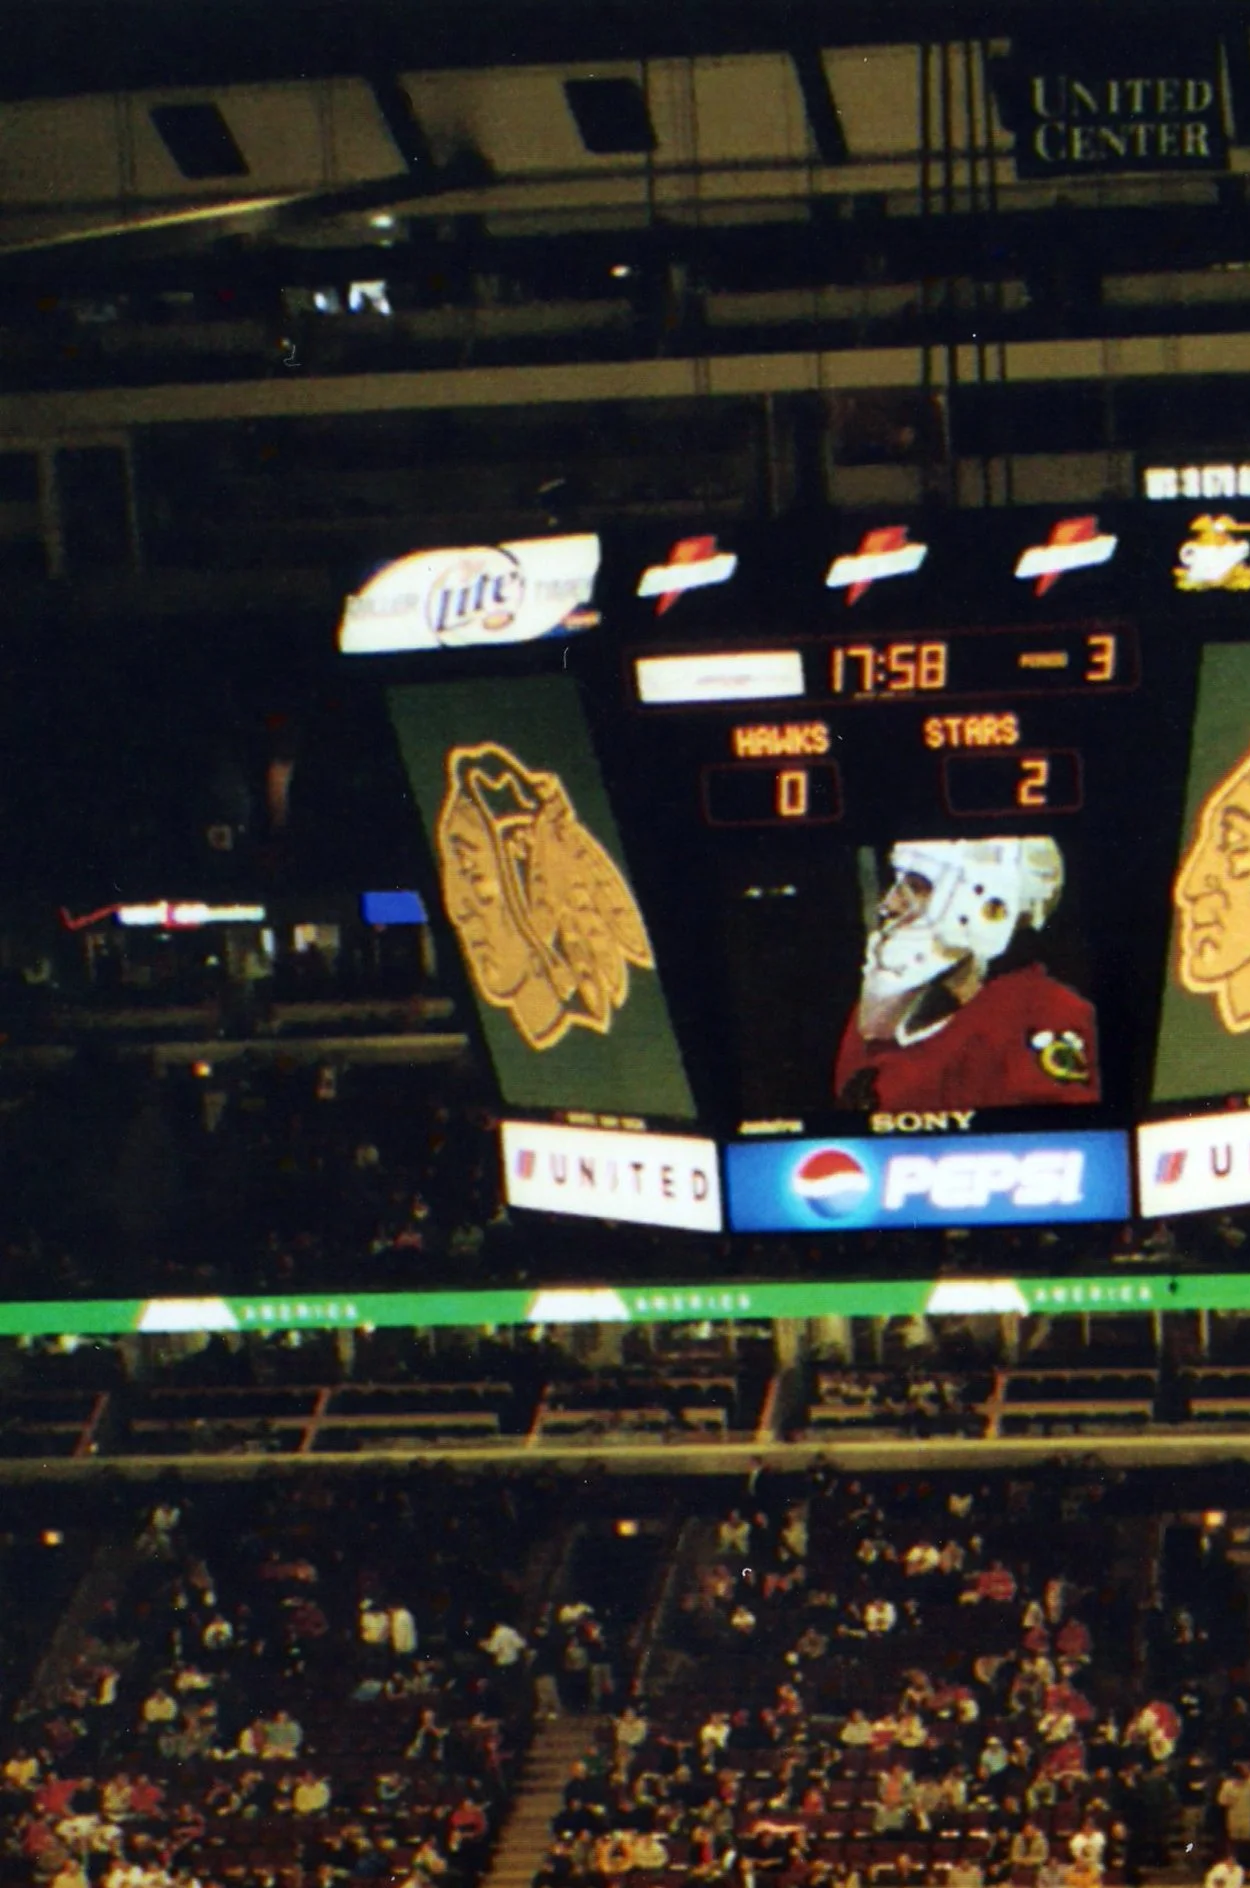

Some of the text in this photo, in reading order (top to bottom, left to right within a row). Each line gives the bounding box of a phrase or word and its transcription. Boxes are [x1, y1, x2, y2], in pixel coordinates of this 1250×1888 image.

[1031, 75, 1213, 118] UNITED
[1034, 121, 1210, 162] CENTER
[831, 642, 946, 692] 17:58
[1085, 634, 1115, 681] 3
[732, 721, 830, 757] HAWKS
[922, 712, 1020, 748] STARS
[778, 770, 806, 816] 0
[1018, 760, 1048, 805] 2
[869, 1111, 974, 1132] SONY
[549, 1153, 709, 1202] UNITED
[884, 1151, 1084, 1209] PEPSI
